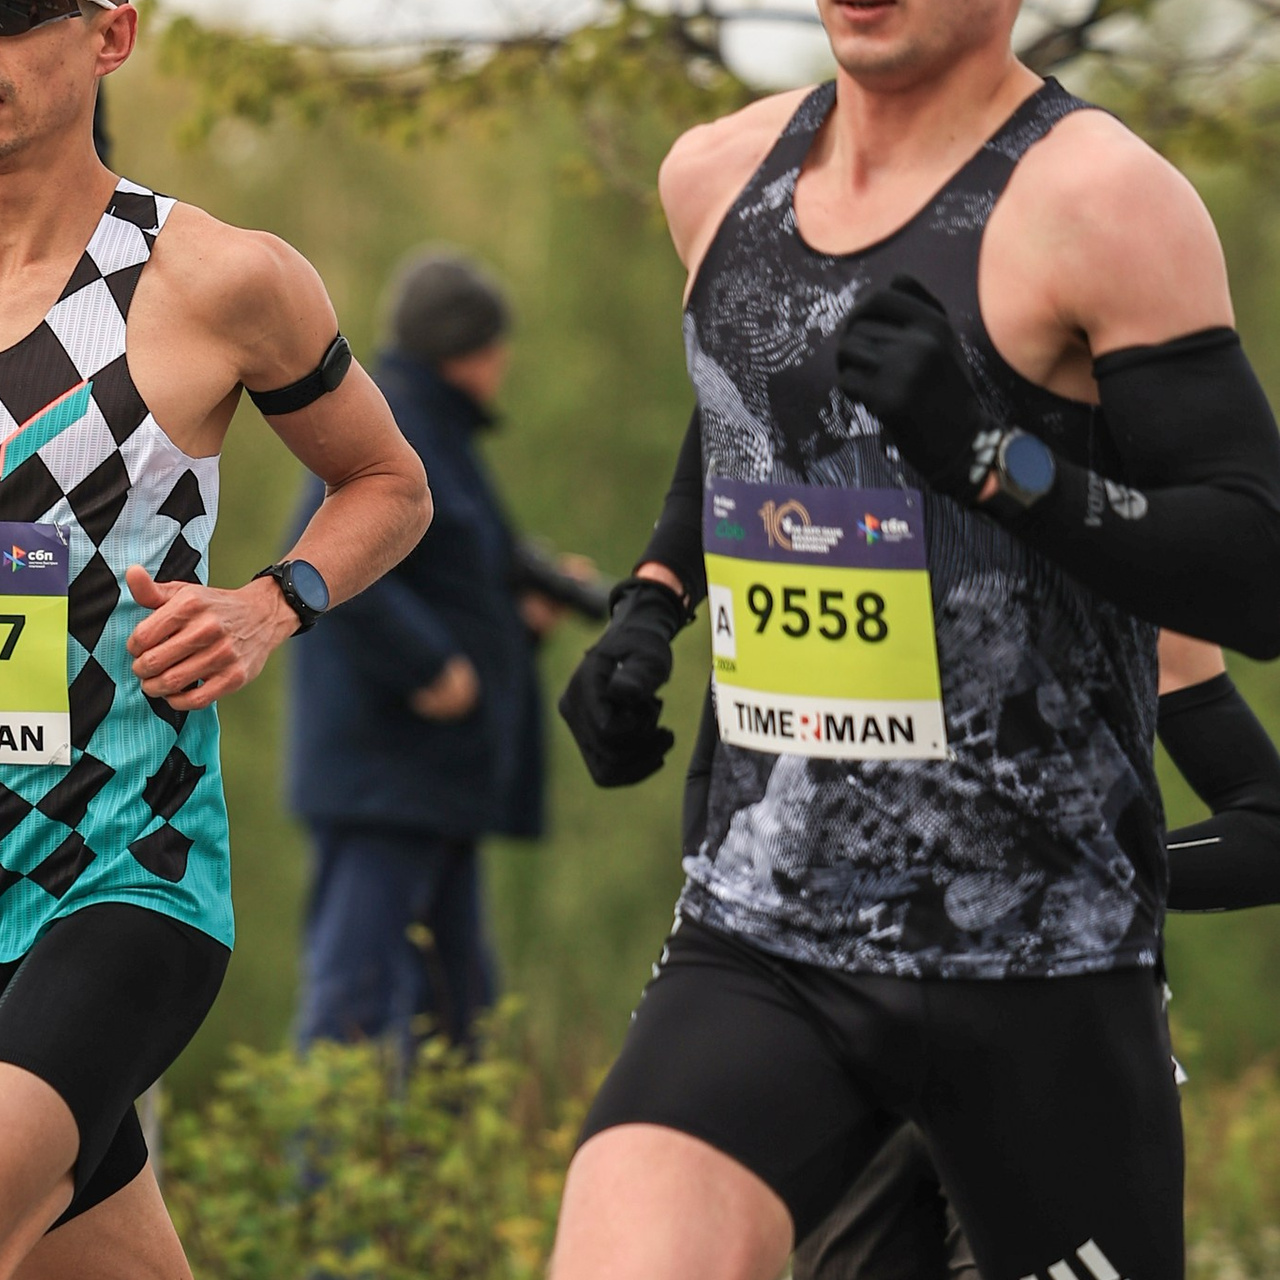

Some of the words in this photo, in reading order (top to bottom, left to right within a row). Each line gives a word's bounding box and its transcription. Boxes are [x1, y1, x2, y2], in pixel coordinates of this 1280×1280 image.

[27, 549, 53, 561] сбп
[716, 605, 732, 638] A
[747, 583, 889, 643] 9558
